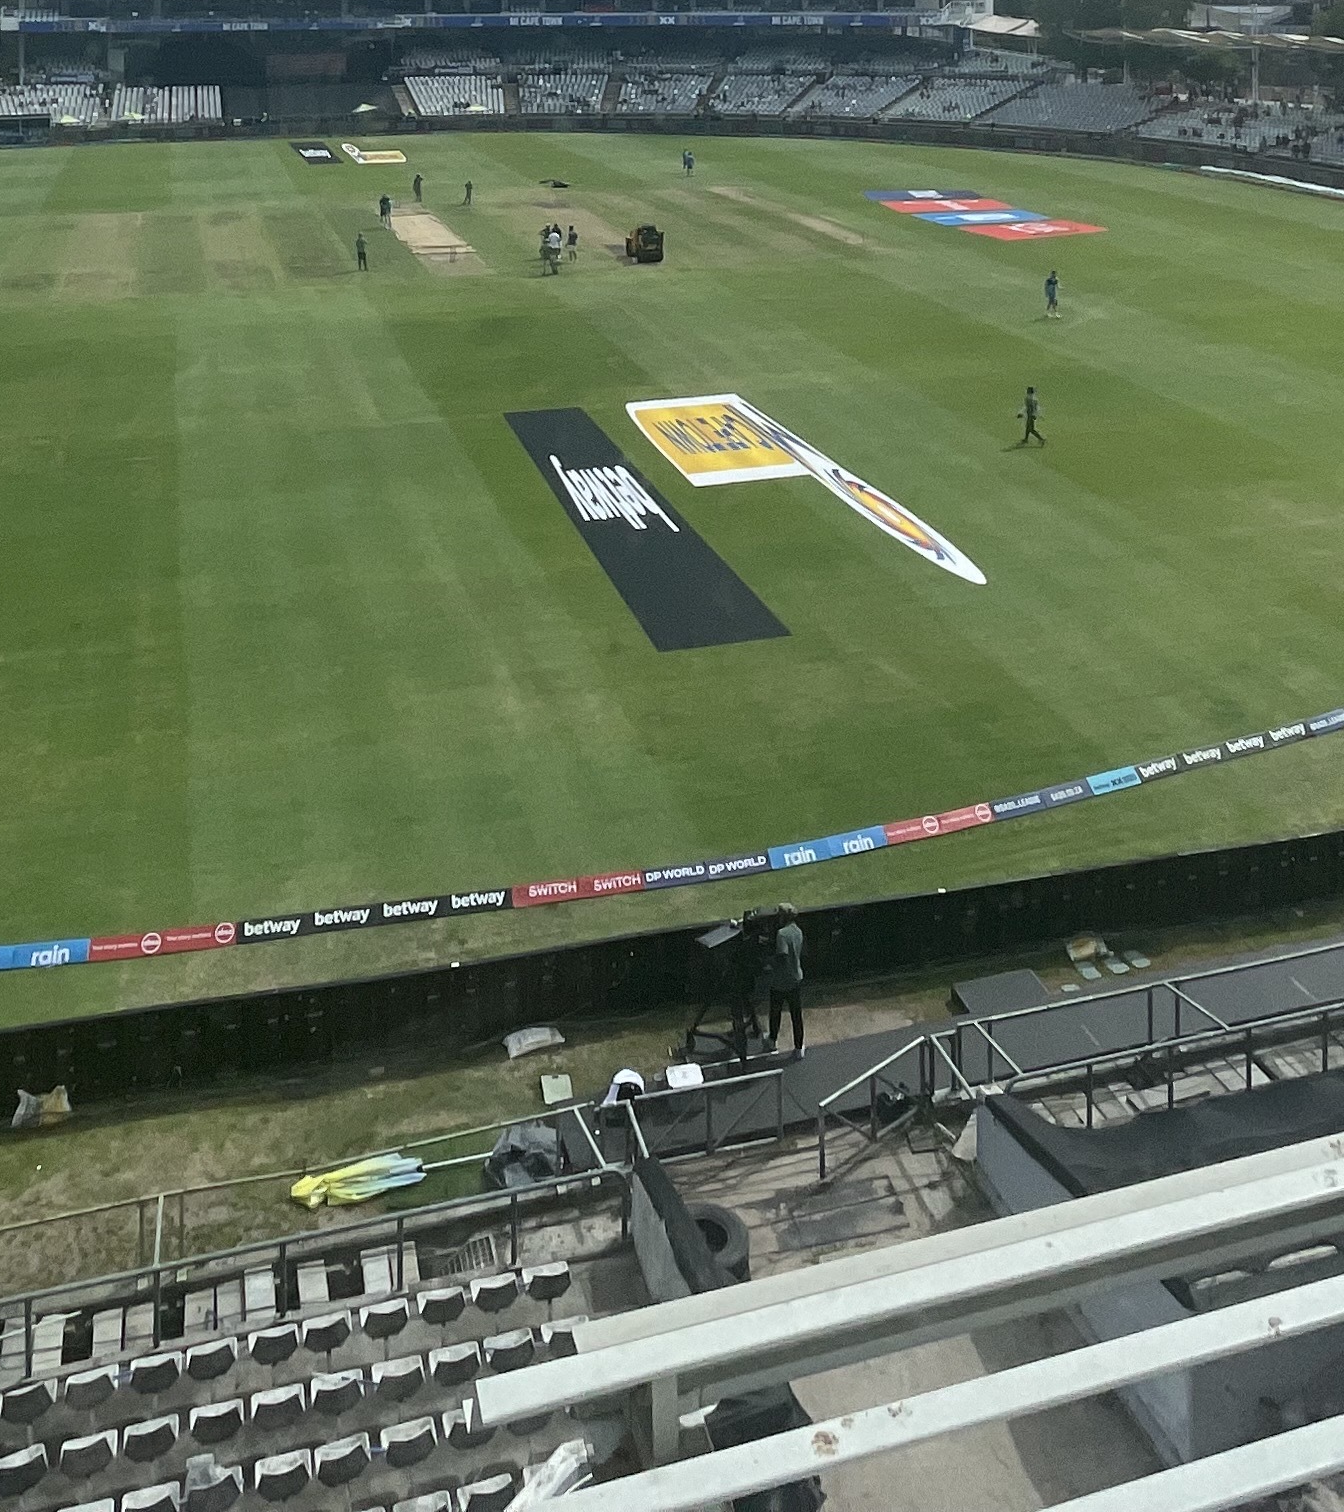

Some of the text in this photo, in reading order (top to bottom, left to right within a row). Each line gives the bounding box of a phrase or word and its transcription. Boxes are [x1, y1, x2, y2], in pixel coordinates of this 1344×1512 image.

[549, 454, 680, 532] betway
[1138, 757, 1177, 779] betway
[1182, 746, 1222, 767] betway
[1226, 734, 1265, 754] betway
[1268, 722, 1307, 742] betway
[783, 834, 875, 868] rain rain
[528, 874, 641, 898] SWITCH SWITCH
[645, 855, 767, 883] DP WORLD DP WORLD
[244, 889, 506, 937] betway betway betway betway
[30, 944, 70, 968] rain
